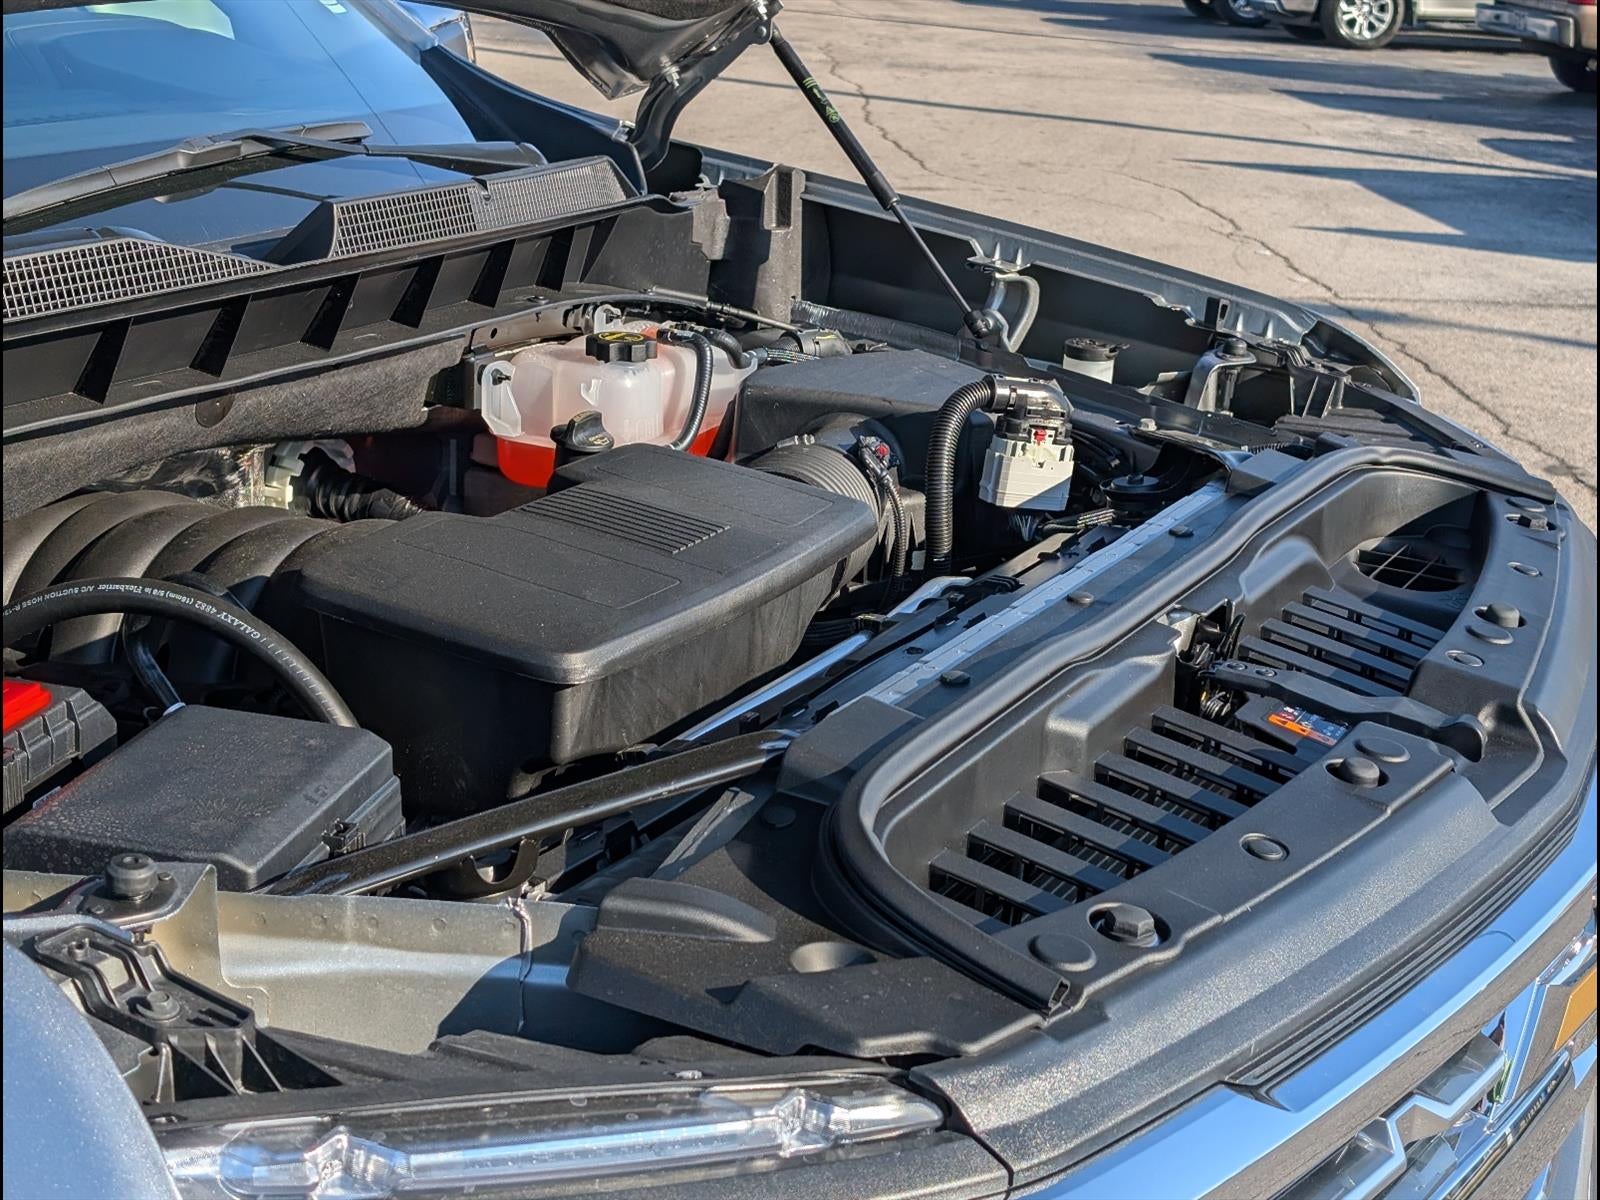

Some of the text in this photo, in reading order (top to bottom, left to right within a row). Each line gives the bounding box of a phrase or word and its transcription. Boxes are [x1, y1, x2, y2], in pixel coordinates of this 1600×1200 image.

[43, 586, 80, 600] SUCTION
[97, 584, 143, 594] Flexbarrier
[22, 595, 43, 608] HOSE
[194, 600, 218, 615] 4882
[217, 610, 261, 639] GALAXY
